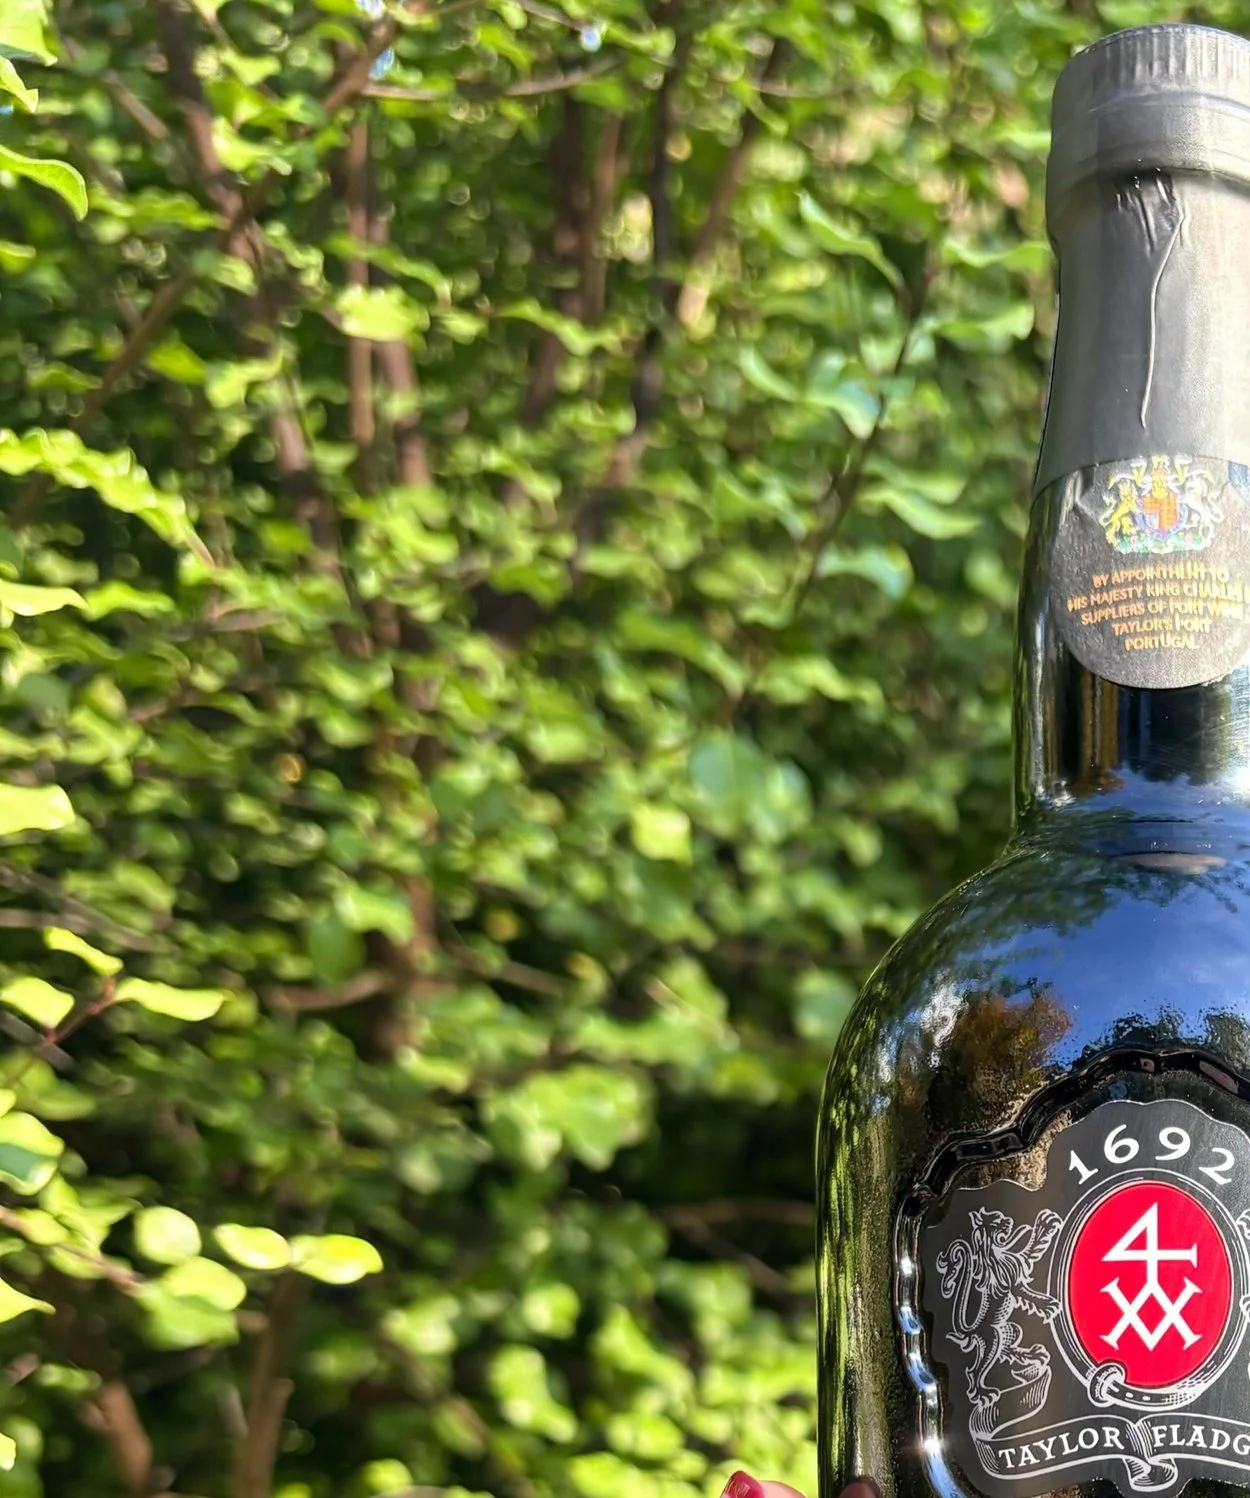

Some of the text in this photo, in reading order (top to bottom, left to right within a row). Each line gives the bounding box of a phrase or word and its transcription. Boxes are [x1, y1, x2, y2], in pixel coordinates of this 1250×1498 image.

[1092, 573, 1110, 589] BY
[1067, 594, 1088, 613] HIS
[1090, 584, 1143, 606] MAJESTY
[1146, 580, 1180, 597] KING
[1081, 602, 1145, 626] SUPPLIERS
[1147, 597, 1169, 614] OF
[1169, 596, 1206, 616] PORT
[1174, 611, 1213, 634] PORT
[1124, 631, 1200, 651] PORTUGAL
[1068, 1123, 1236, 1185] 1692
[999, 1423, 1126, 1470] TAYLOR
